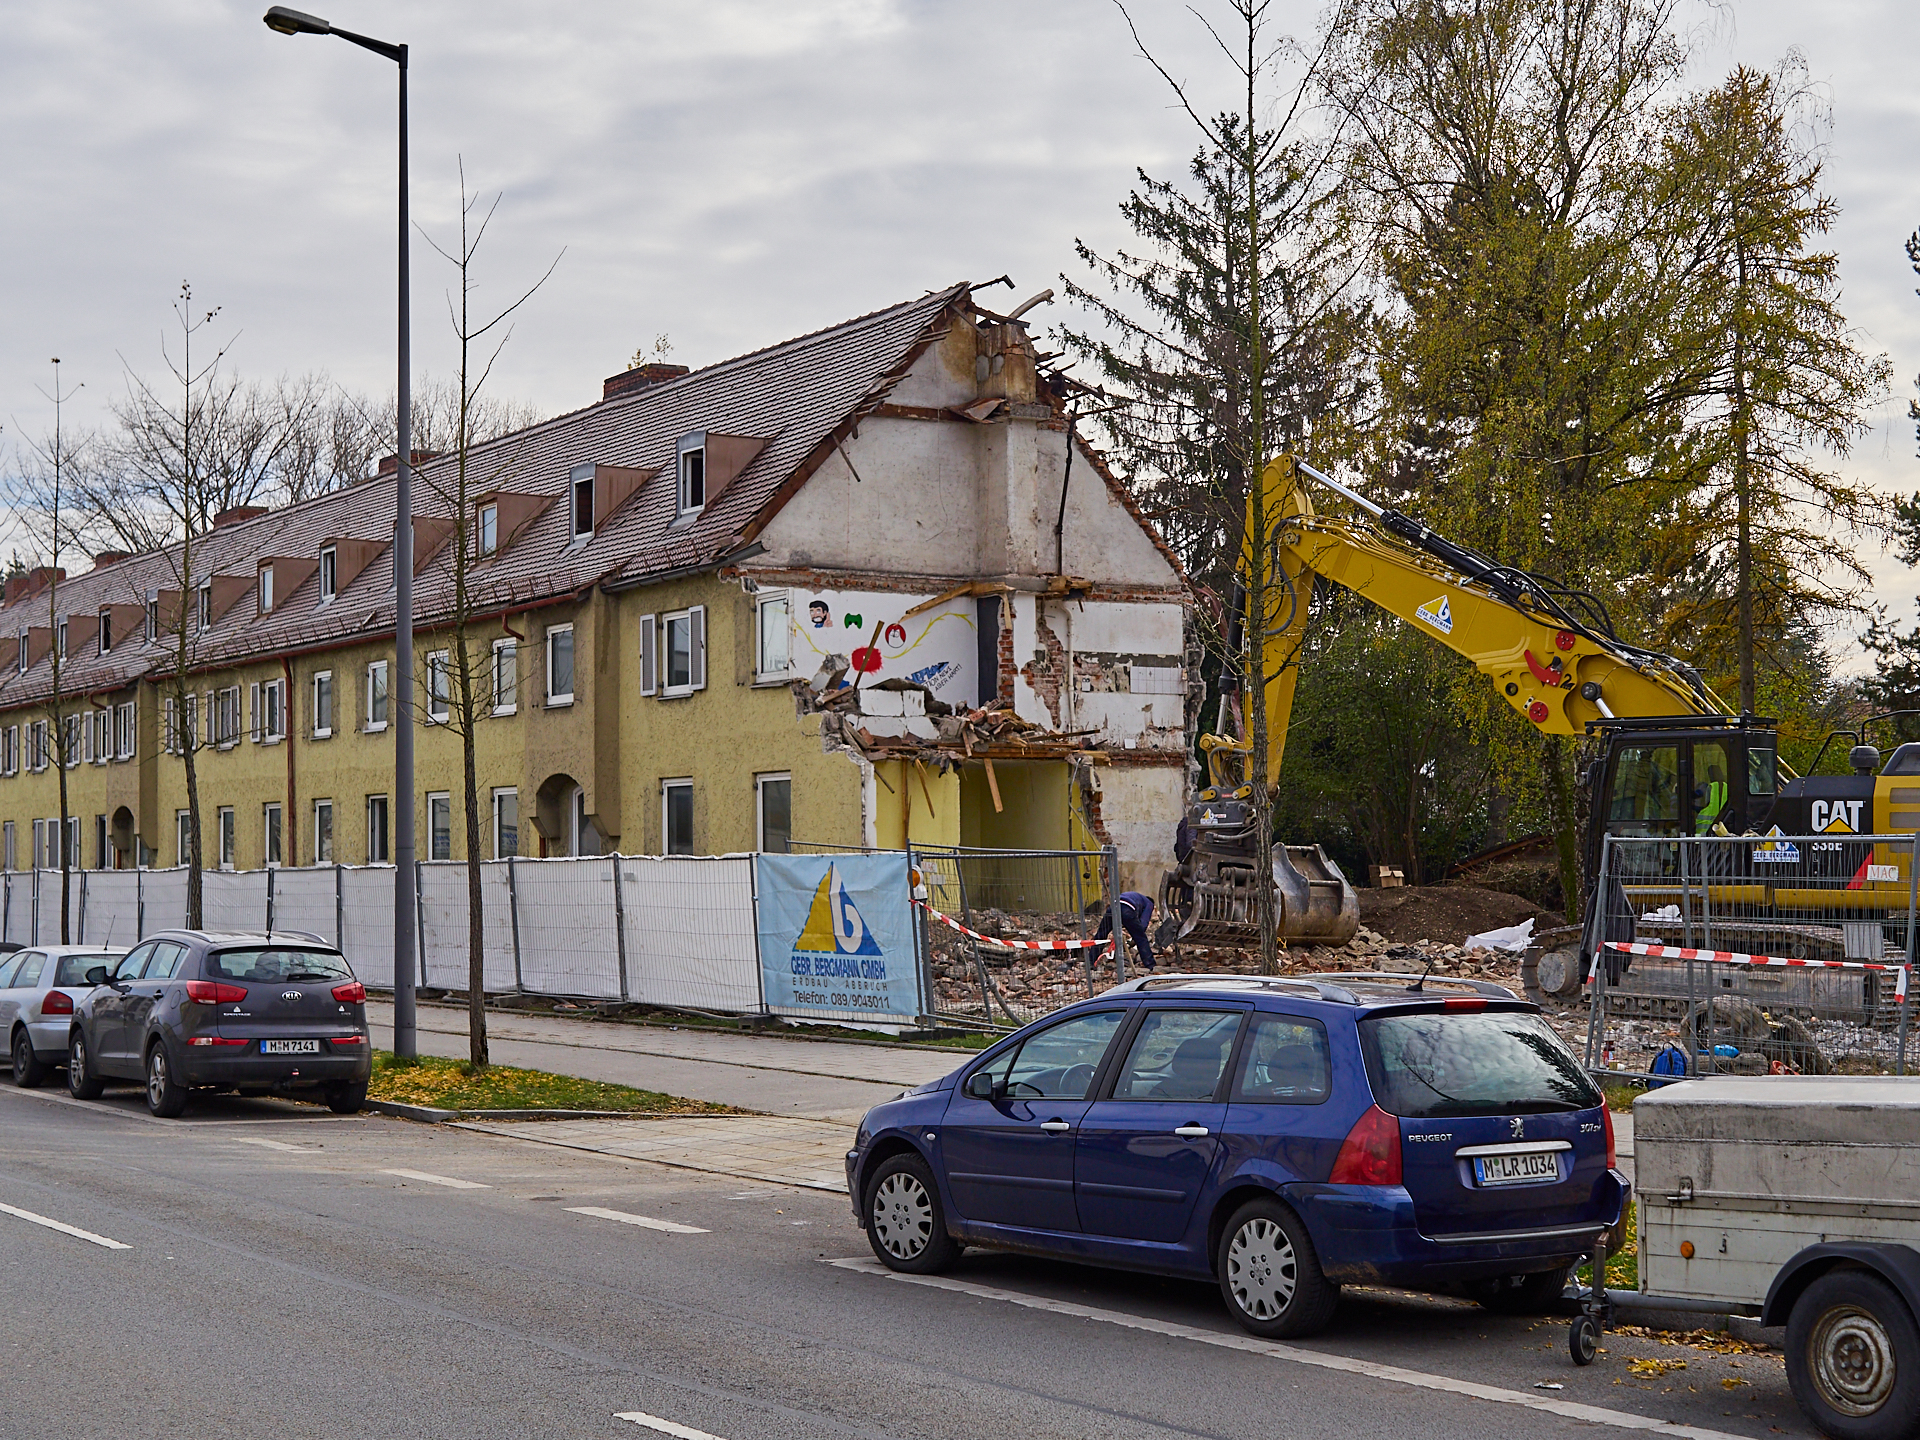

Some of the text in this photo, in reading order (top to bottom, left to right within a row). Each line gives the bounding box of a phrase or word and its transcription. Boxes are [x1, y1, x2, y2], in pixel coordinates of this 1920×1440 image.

[1811, 800, 1863, 832] CAT
[791, 956, 886, 980] GEBR. BERGMANN GMBH
[793, 977, 828, 988] ERDBAU
[284, 991, 300, 1000] KIA
[793, 990, 890, 1009] Telefon: 089/9043011
[291, 1041, 315, 1051] 7141
[1408, 1133, 1453, 1143] PEUGEOT
